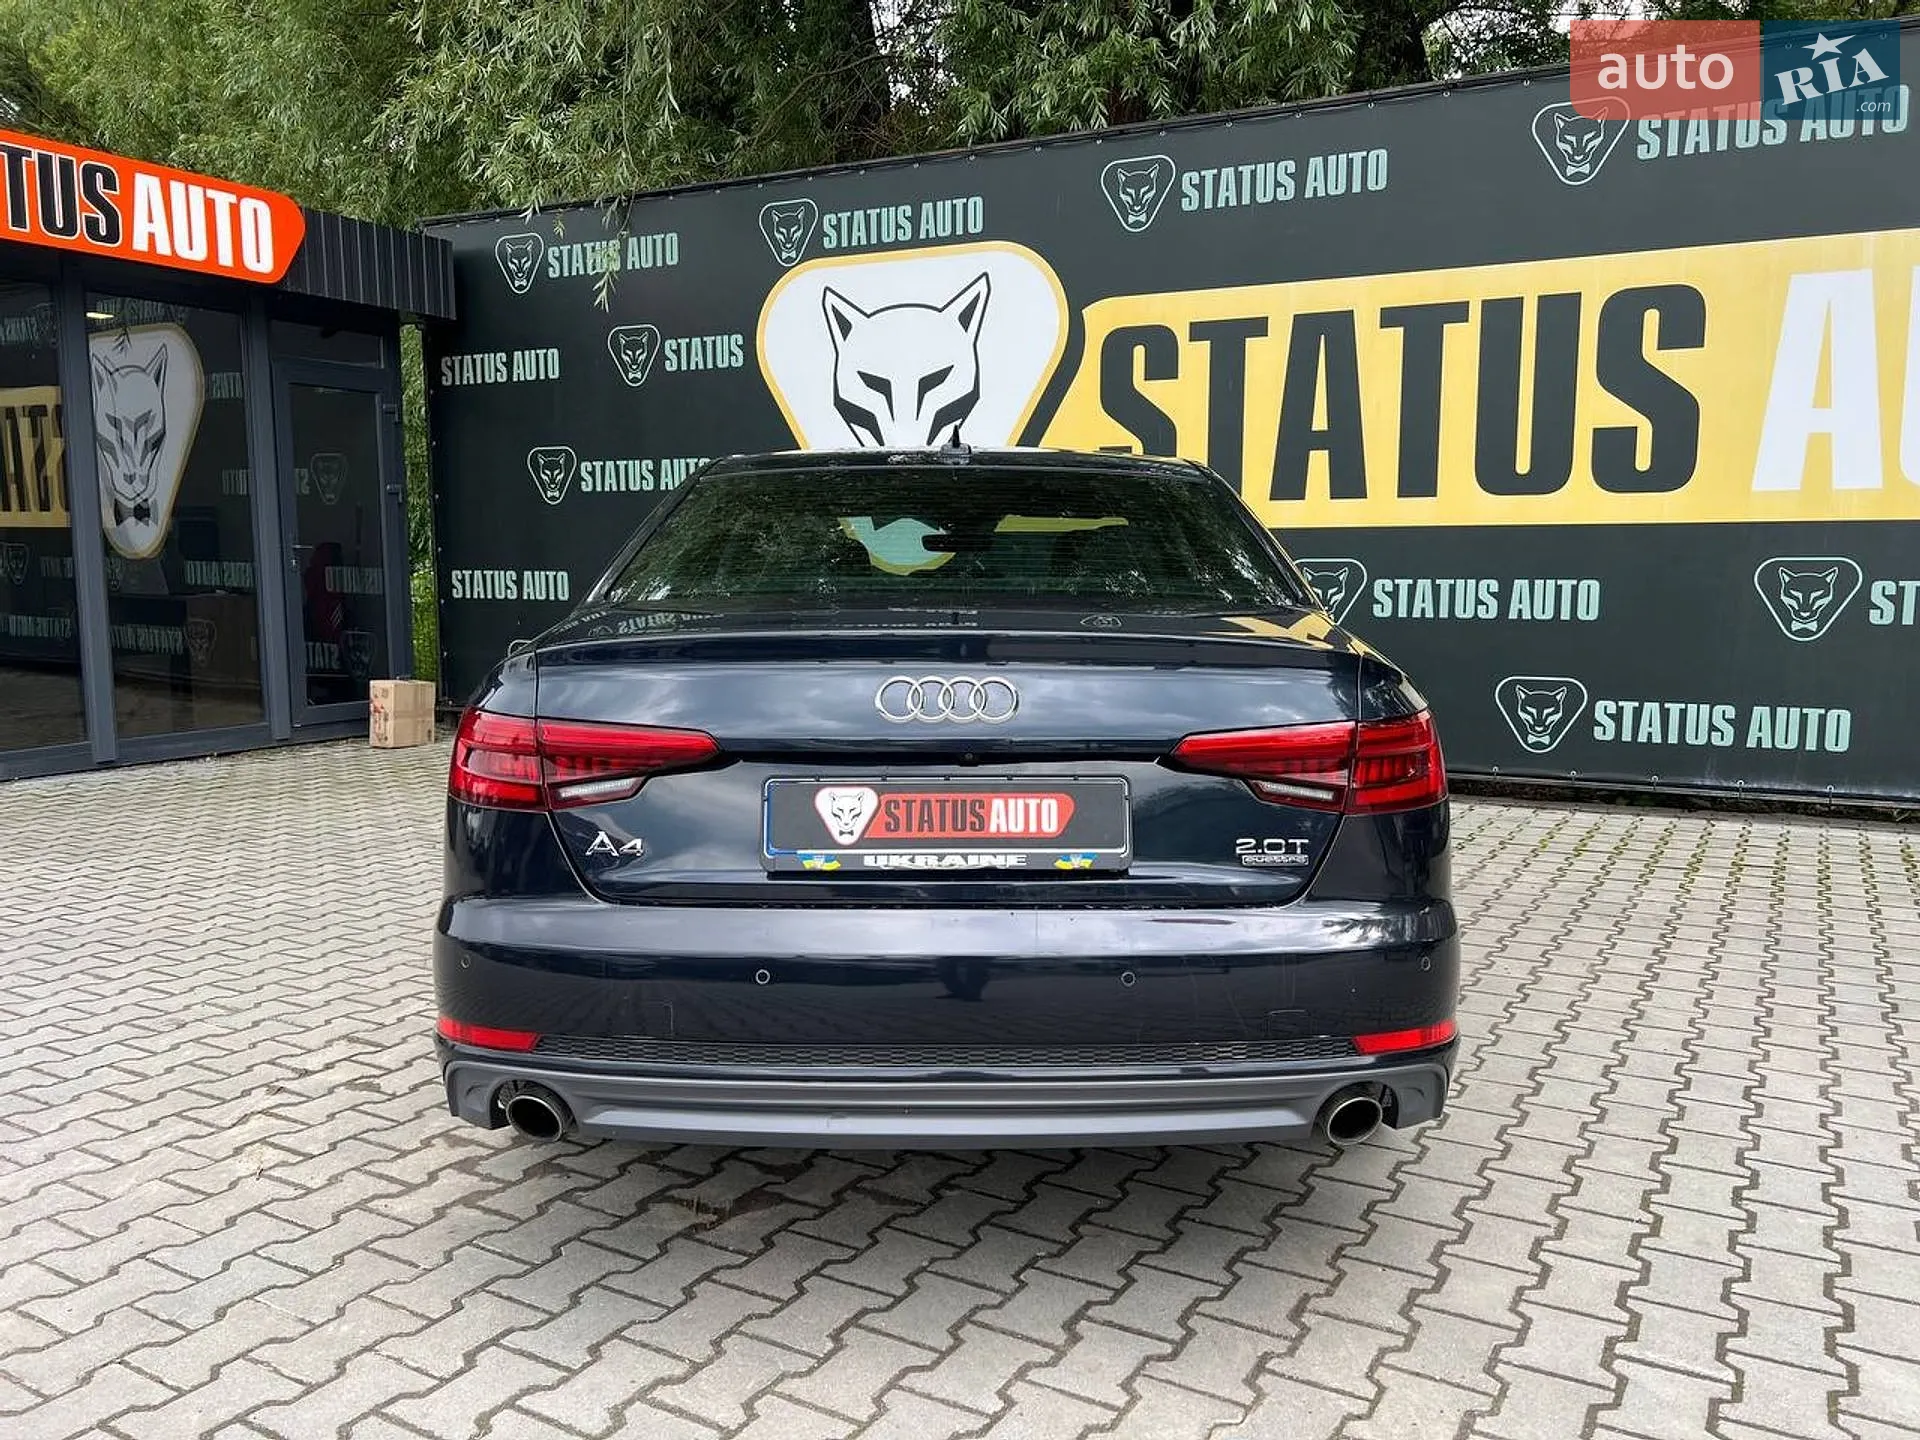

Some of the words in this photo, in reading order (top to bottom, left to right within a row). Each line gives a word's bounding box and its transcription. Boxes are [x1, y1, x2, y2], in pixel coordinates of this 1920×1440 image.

[1636, 98, 1788, 161] STATUS
[1799, 84, 1910, 143] AUTO
[1181, 159, 1296, 212] STATUS
[1304, 148, 1388, 199] AUTO
[132, 172, 274, 273] AUTO
[823, 204, 912, 249] STATUS
[919, 196, 984, 240] AUTO
[547, 240, 621, 279] STATUS
[626, 232, 679, 270] AUTO
[441, 352, 508, 386] STATUS
[512, 348, 560, 382] AUTO
[665, 334, 744, 372] STATUS
[1099, 283, 1707, 500] STATUS
[1752, 265, 1920, 492] A
[580, 459, 654, 492] STATUS
[659, 457, 712, 491] AUT
[452, 569, 518, 600] STATUS
[522, 570, 570, 601] AUTO
[1372, 579, 1500, 620] STATUS
[1508, 578, 1600, 621] AUTO
[1592, 700, 1737, 747] STATUS
[1745, 706, 1852, 752] AUTO
[884, 798, 986, 834] STATUS
[988, 798, 1058, 833] AUTO
[585, 831, 643, 857] A4
[862, 853, 1031, 870] UKRAINE
[1236, 838, 1309, 854] 2.0T
